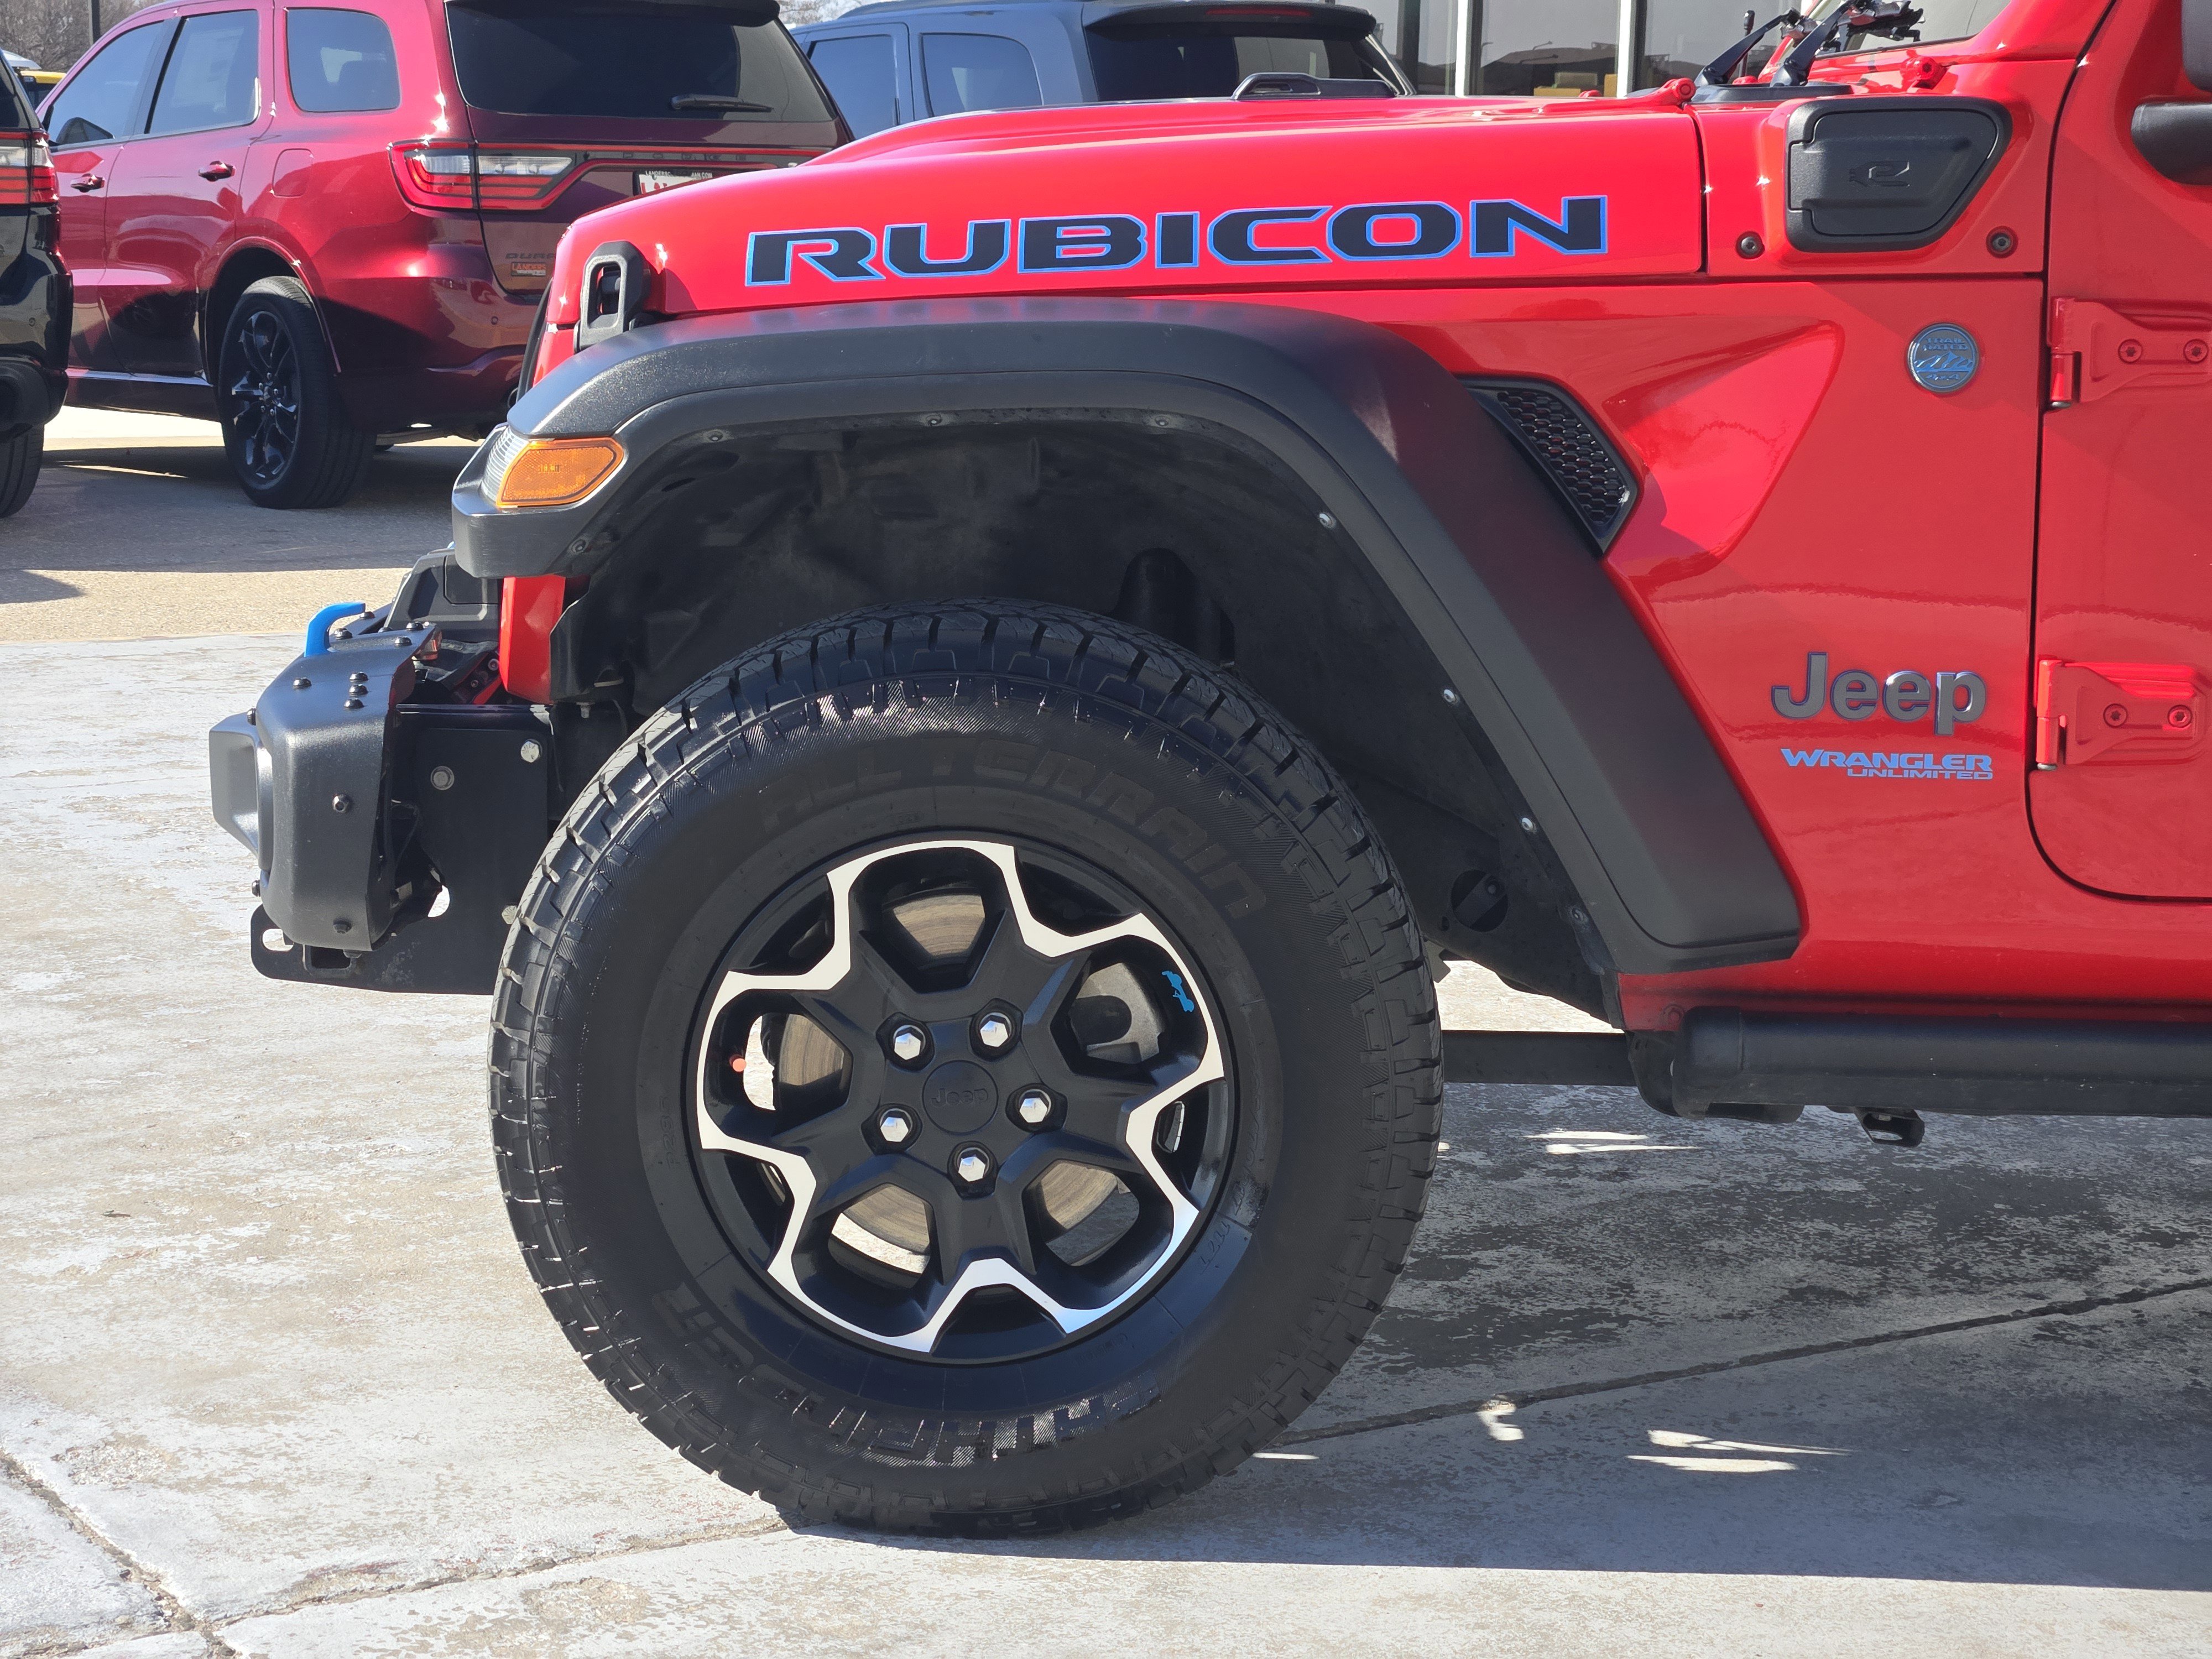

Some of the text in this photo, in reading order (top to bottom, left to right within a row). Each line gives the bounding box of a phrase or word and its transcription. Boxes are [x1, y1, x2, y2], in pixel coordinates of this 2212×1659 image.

[744, 195, 1608, 287] RUBICON
[1771, 652, 1986, 736] Jeep
[1780, 748, 1993, 771] WRANGLER
[1847, 768, 1994, 780] UNLIMITED
[755, 744, 904, 835] ALL
[914, 737, 1269, 921] TERRAIN
[931, 1087, 989, 1108] Jeep
